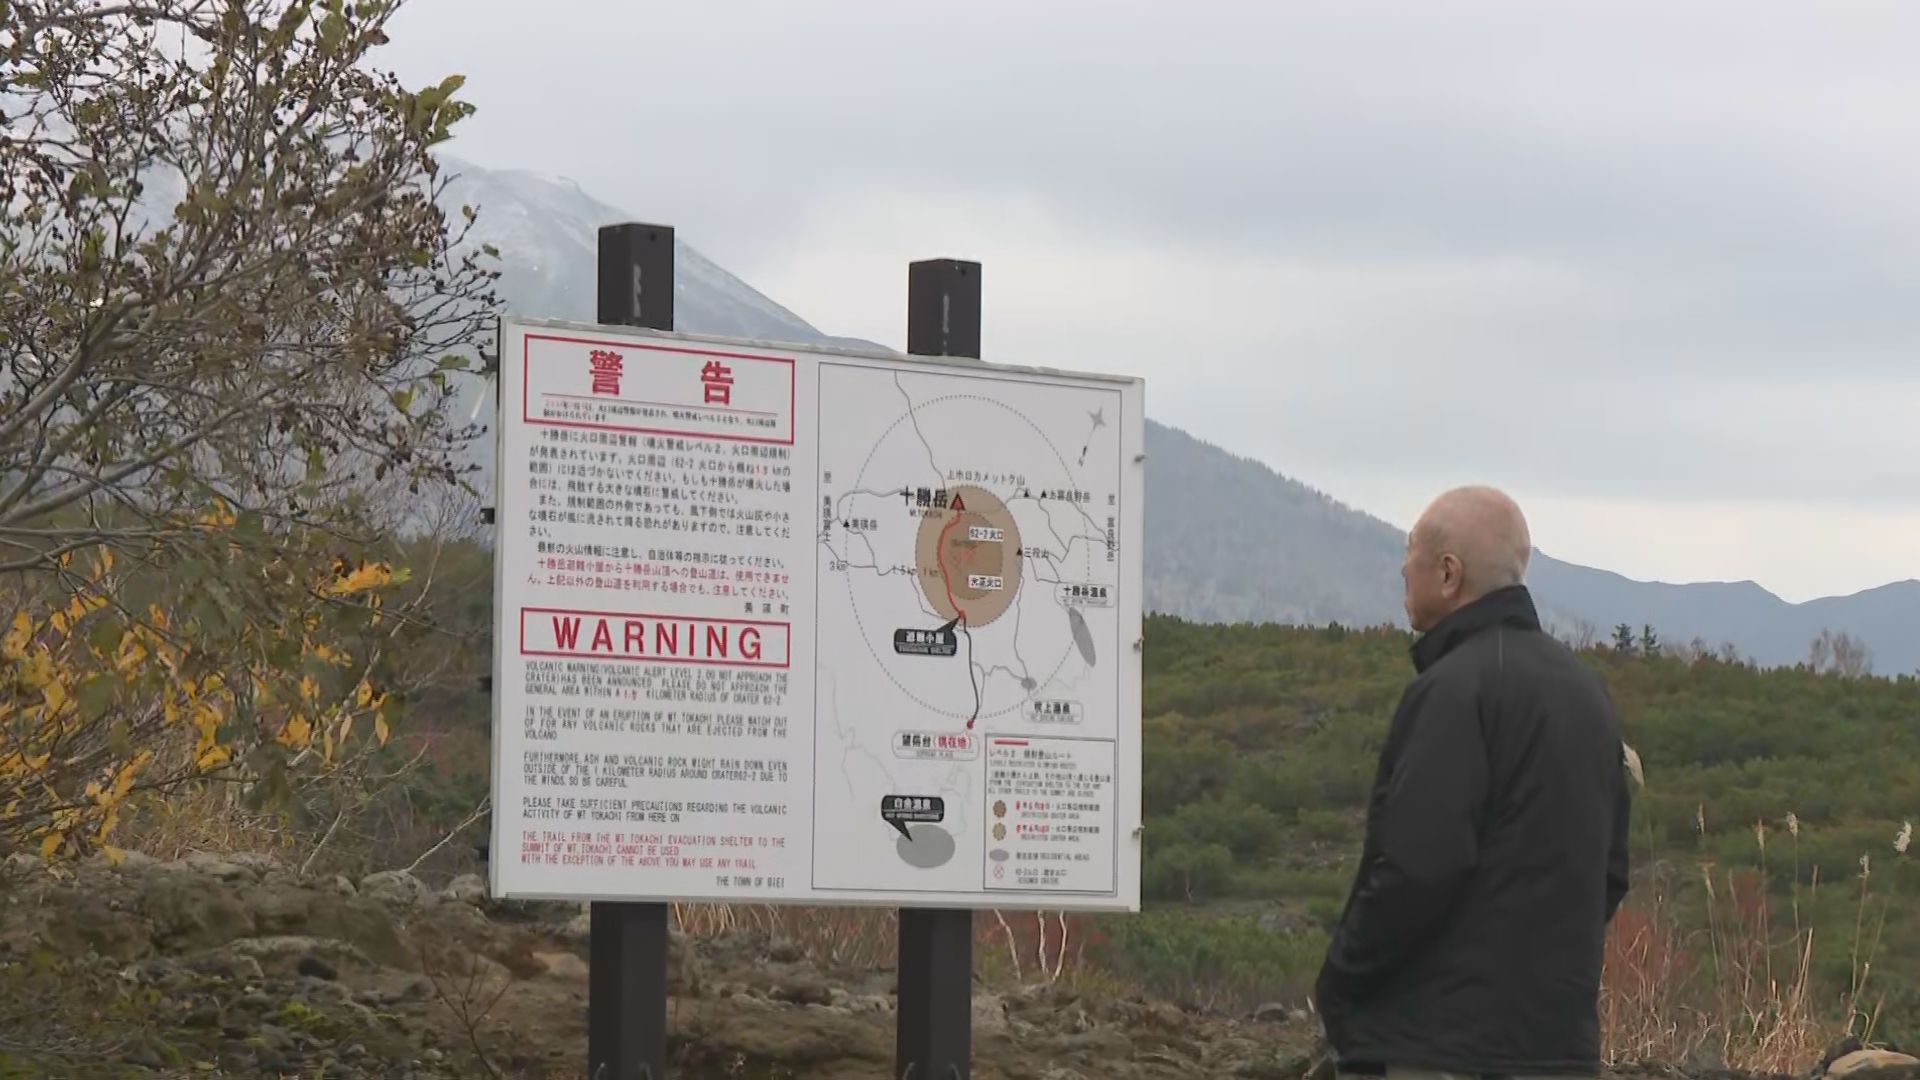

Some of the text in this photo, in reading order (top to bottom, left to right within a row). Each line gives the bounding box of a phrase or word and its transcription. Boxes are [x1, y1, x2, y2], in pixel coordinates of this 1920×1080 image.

[589, 350, 734, 405] 警告
[900, 485, 948, 508] 十勝岳
[529, 525, 552, 538] さい。
[552, 616, 761, 660] WARNING
